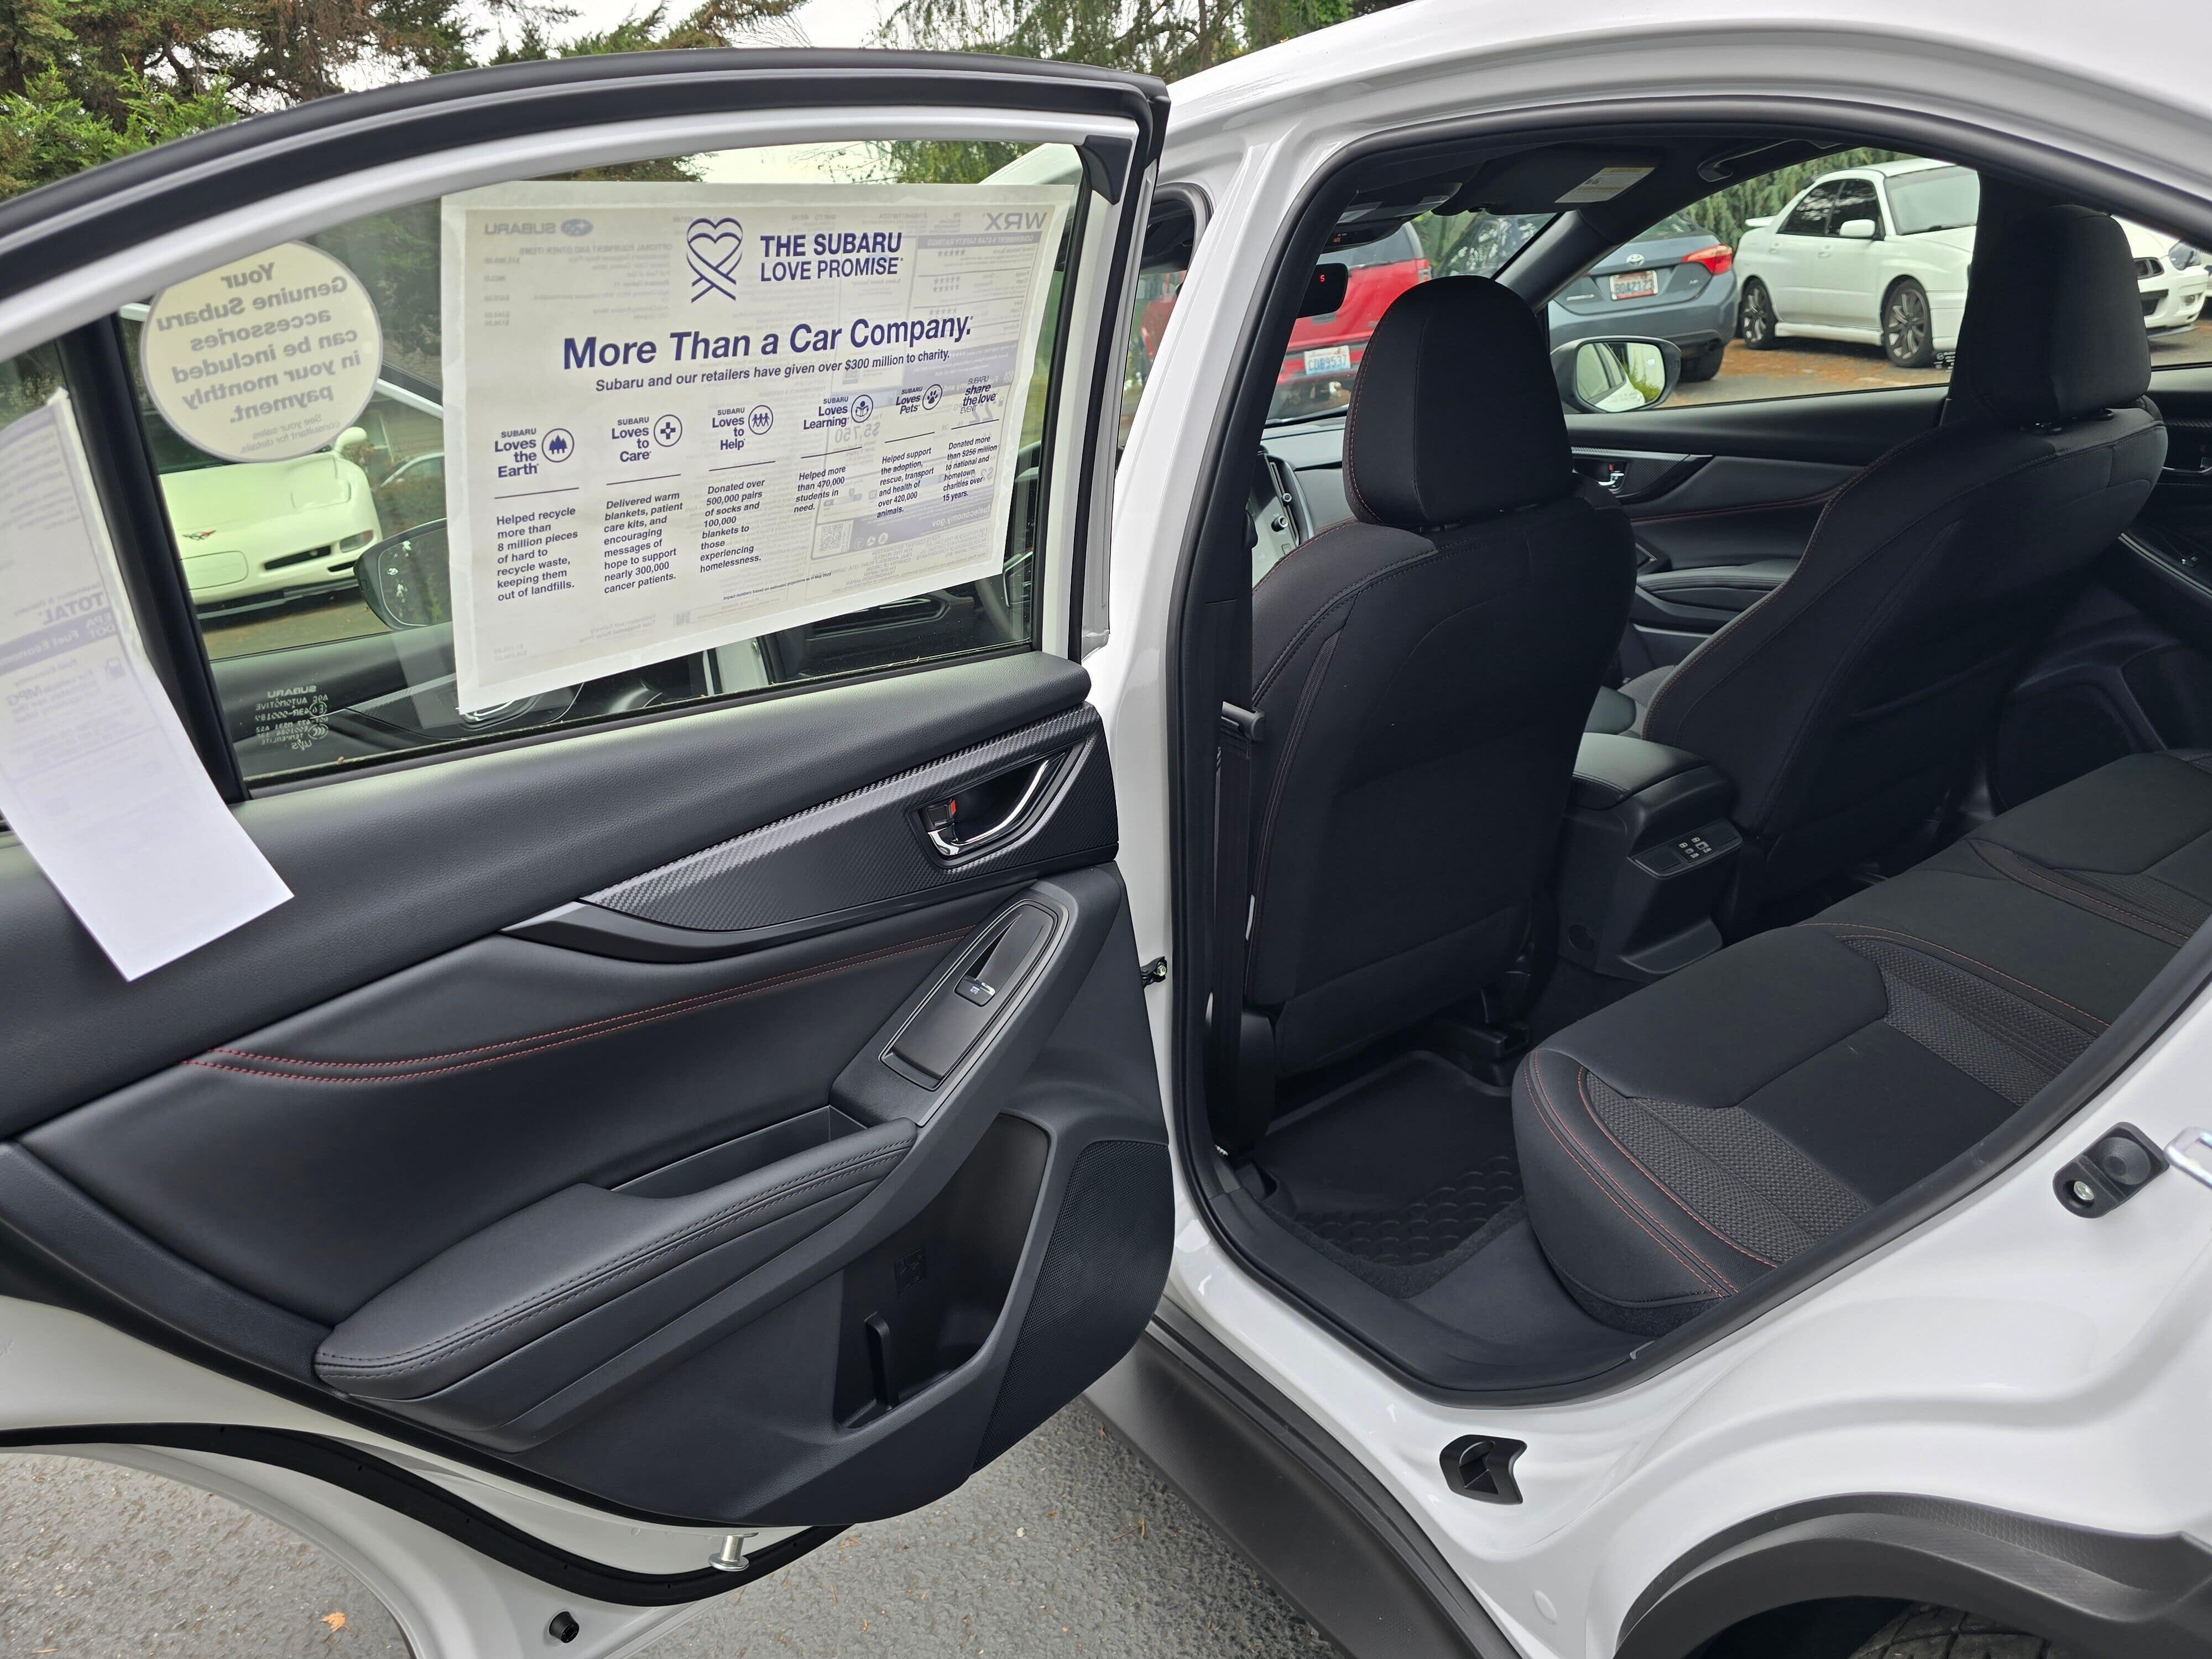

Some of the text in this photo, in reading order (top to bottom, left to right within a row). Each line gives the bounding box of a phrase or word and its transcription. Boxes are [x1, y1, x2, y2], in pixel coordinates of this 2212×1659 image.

[760, 232, 902, 258] THE SUBARU
[760, 257, 899, 282] LOVE PROMISE
[564, 315, 972, 369] More Than a Car Company.
[596, 348, 950, 392] Subaru and our retailers have given over $300 million to charity.
[967, 375, 989, 385] SUBARU
[901, 386, 923, 395] SUBARU
[964, 384, 991, 396] share
[823, 396, 849, 404] SUBARU
[895, 395, 921, 406] Loves
[717, 407, 745, 416] SUBARU
[818, 405, 848, 417] Loves
[899, 404, 918, 415] Pets
[960, 404, 978, 414] EVENT
[617, 416, 649, 426] SUBARU
[712, 417, 744, 428] Loves
[803, 416, 848, 430] Learning
[501, 427, 536, 439] SUBARU
[612, 427, 649, 440] Loves
[733, 427, 744, 437] to
[494, 439, 536, 452] Loves
[636, 438, 649, 449] to
[720, 438, 744, 451] Help
[948, 436, 991, 450] Donated more
[513, 450, 537, 463] the
[619, 450, 650, 462] Care
[881, 447, 931, 465] Helped support
[947, 445, 998, 461] than $256 million
[880, 461, 923, 475] the adoption,
[953, 457, 978, 469] national
[978, 455, 990, 463] and
[498, 462, 538, 478] Earth
[799, 466, 846, 481] Helped more
[880, 467, 934, 486] rescue, transport
[943, 469, 975, 481] hometown
[707, 479, 765, 494] Donated over
[797, 476, 845, 492] than 470,000
[879, 479, 921, 497] and health of
[943, 477, 983, 492] charities over
[606, 492, 680, 509] Delivered warm
[706, 491, 763, 506] 500,000 pairs
[795, 491, 830, 503] students
[878, 491, 918, 508] over 420,000
[942, 491, 969, 502] 15 years.
[604, 502, 683, 521] blankets, patient
[705, 501, 760, 517] of socks and
[794, 503, 815, 513] need.
[877, 506, 904, 518] animals.
[496, 507, 576, 525] Helped recycle
[703, 515, 737, 528] 100,000
[497, 524, 551, 539] more than
[604, 515, 667, 533] care kits, and
[604, 529, 662, 545] encouraging
[702, 526, 739, 539] blankets
[497, 531, 578, 552] 8 million pieces
[604, 538, 662, 557] messages of
[701, 540, 726, 550] those
[497, 549, 548, 564] of hard to
[604, 547, 677, 570] hope to support
[700, 545, 754, 561] experiencing
[497, 557, 570, 576] recycle waste,
[604, 561, 669, 582] nearly 300,000
[700, 555, 761, 573] homelessness.
[497, 570, 567, 588] keeping them
[604, 573, 676, 594] cancer patients.
[498, 580, 575, 601] out of landfills.
